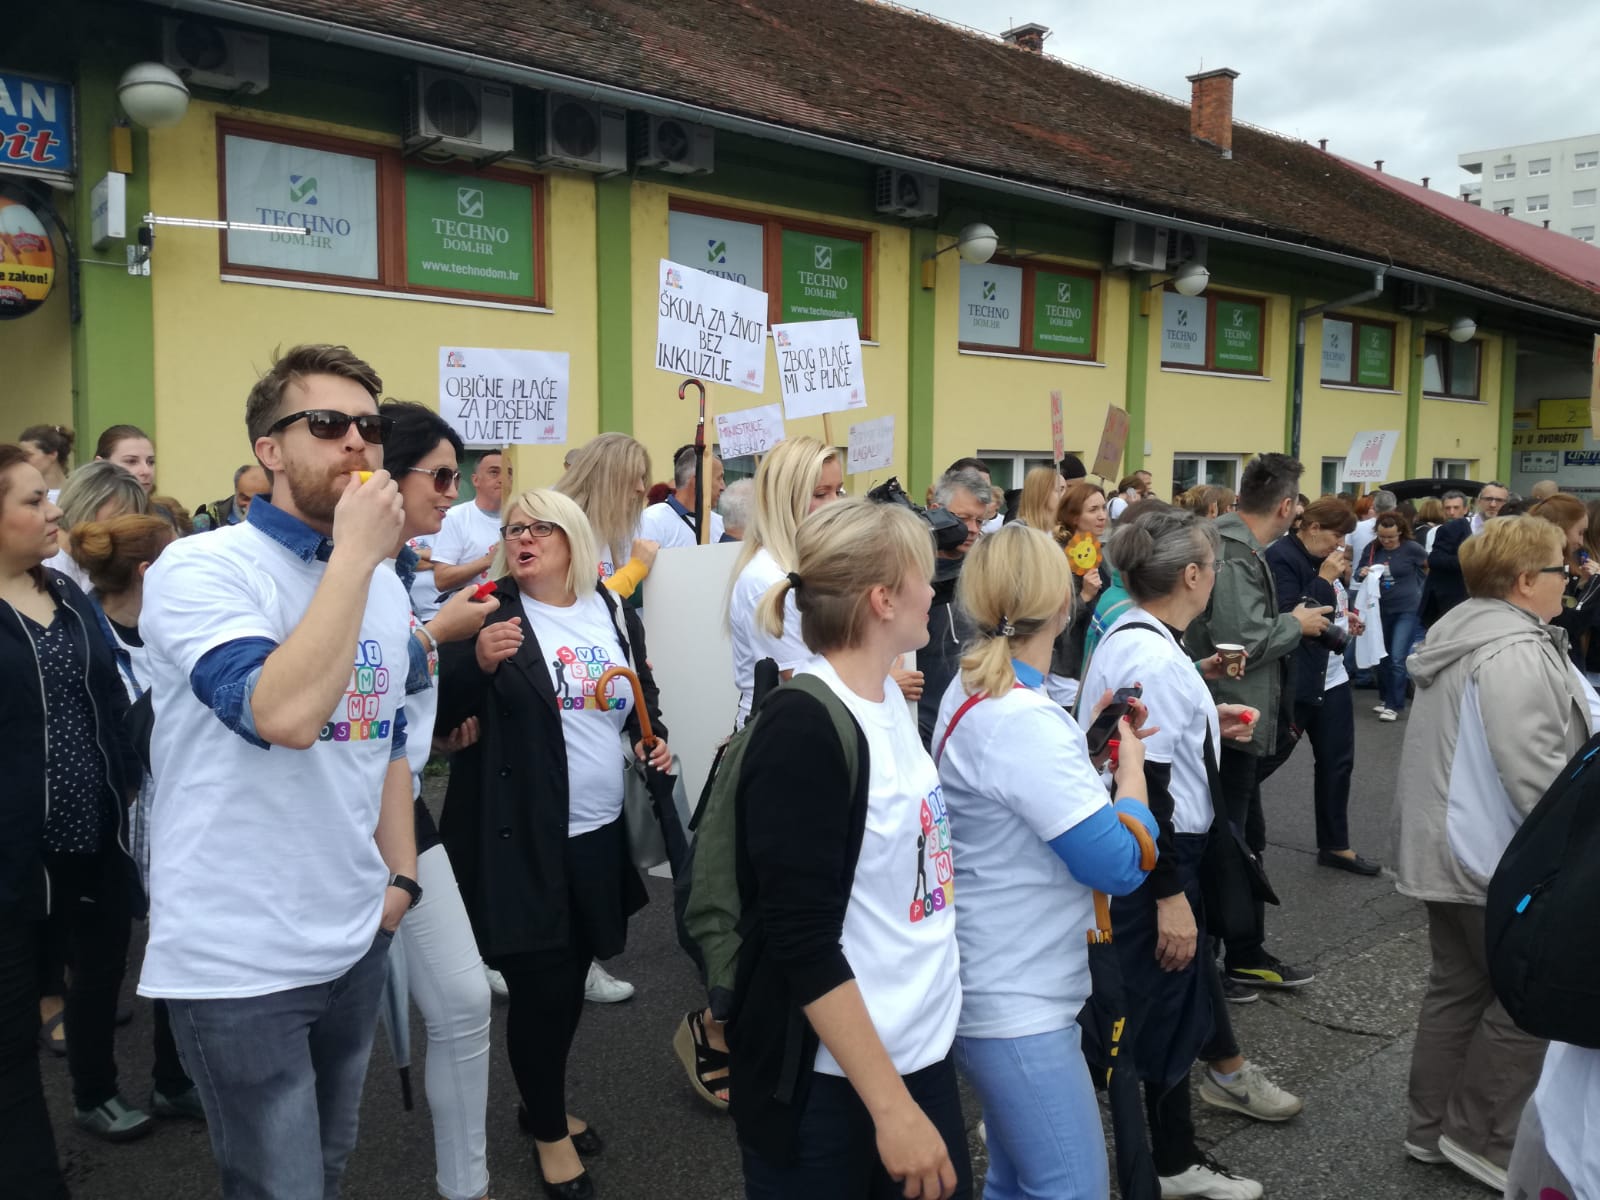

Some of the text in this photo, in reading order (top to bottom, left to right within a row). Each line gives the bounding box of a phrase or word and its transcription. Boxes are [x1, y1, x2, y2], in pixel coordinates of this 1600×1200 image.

[255, 207, 351, 237] TECHNO
[431, 217, 509, 244] TECHNO
[269, 231, 332, 249] DOM.HR
[442, 238, 494, 256] DOM.HR
[8, 270, 48, 284] zakon!
[422, 259, 520, 281] www.technodom.hr
[797, 270, 848, 290] TECHNO
[804, 286, 838, 299] DOM.HR
[660, 289, 764, 345] ŠKOLA ZA ŽIVOT
[968, 304, 1009, 320] TECHNO
[1045, 304, 1081, 320] TECHNO
[699, 330, 723, 354] BEZ
[1167, 329, 1197, 342] TECHNO
[658, 342, 733, 382] INKLUZIJE
[782, 340, 852, 372] ZBOG PLAĆE
[446, 375, 558, 399] OBIČNE PLAĆE
[784, 373, 799, 394] MI
[804, 371, 817, 392] SE
[458, 398, 556, 421] ZA POSEBNE
[465, 420, 522, 440] UVJETE
[559, 648, 607, 662] SVI
[349, 696, 377, 719] MI
